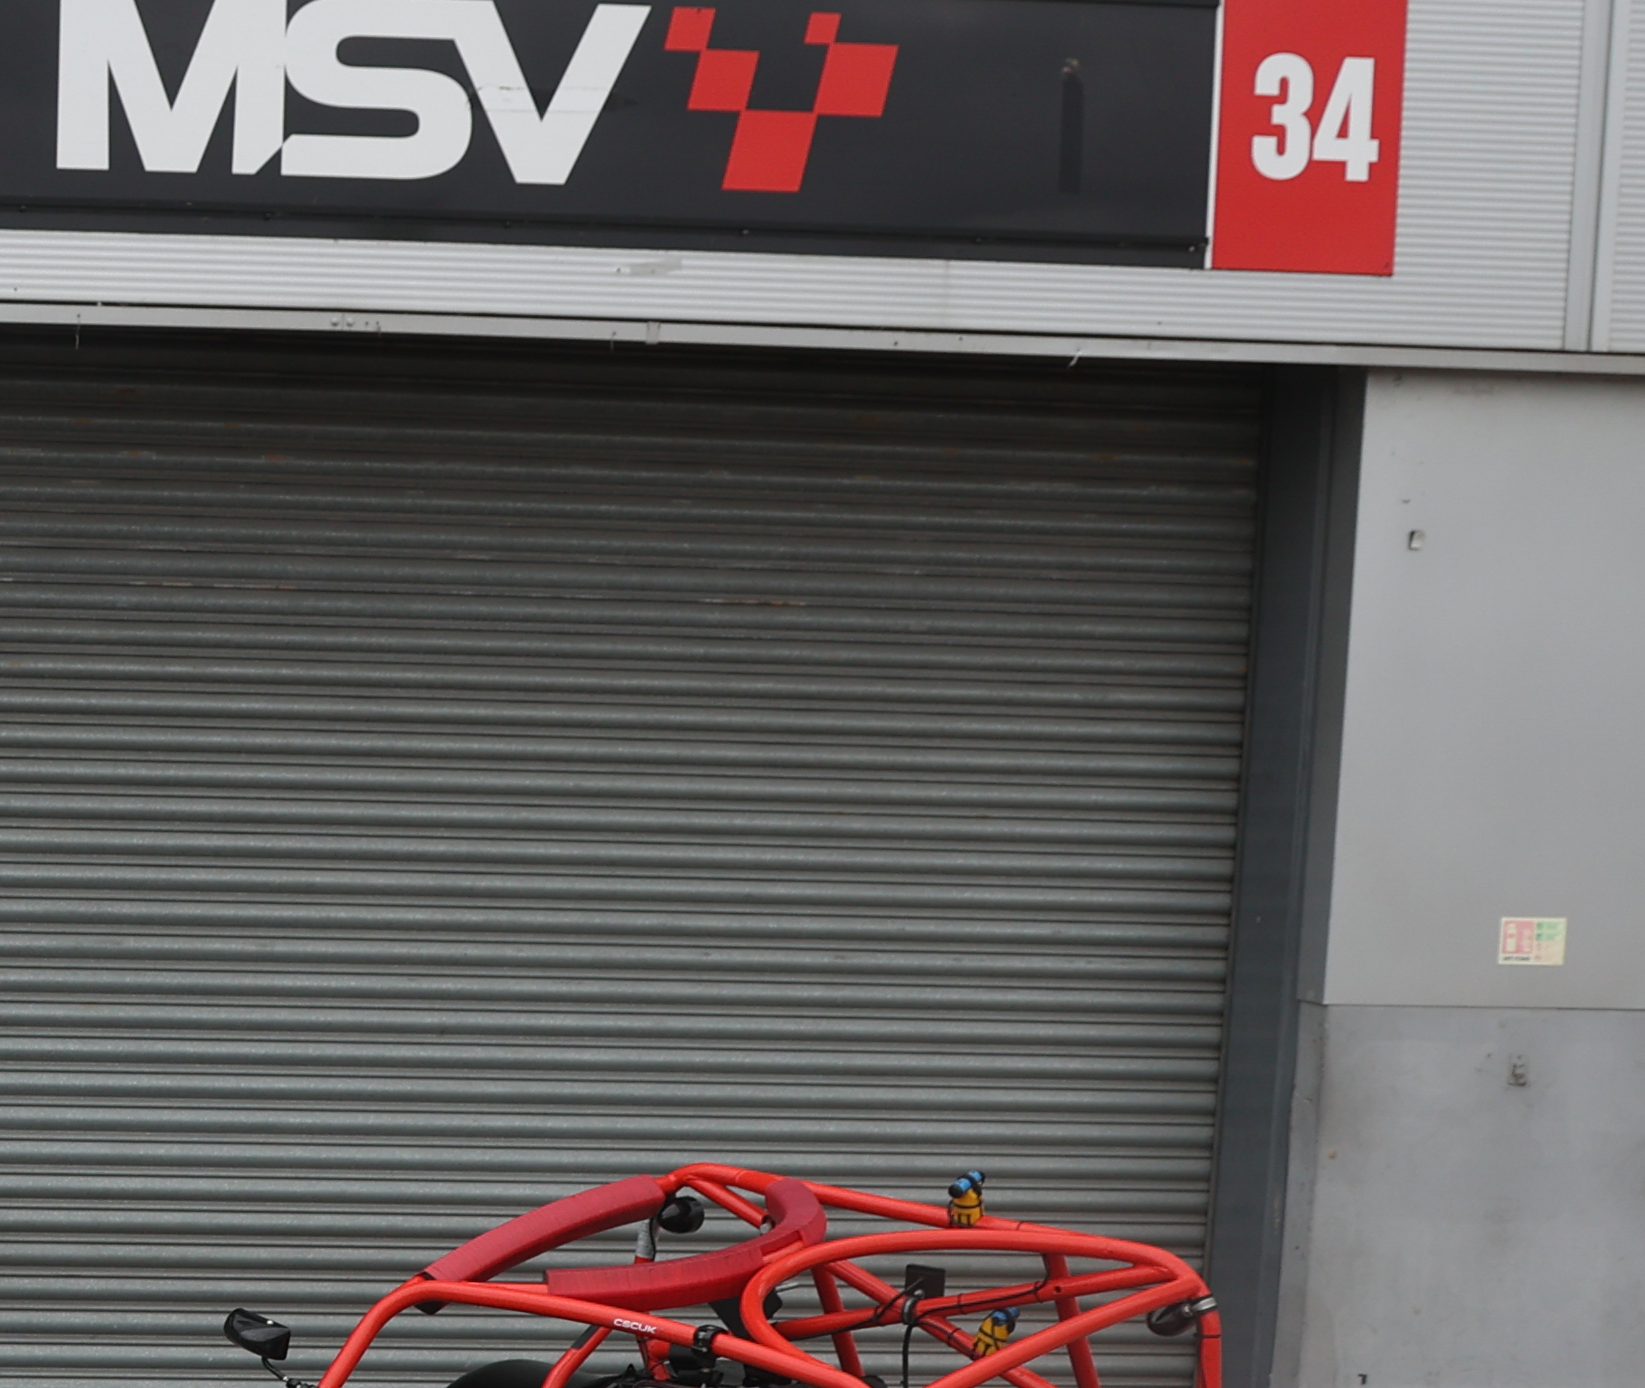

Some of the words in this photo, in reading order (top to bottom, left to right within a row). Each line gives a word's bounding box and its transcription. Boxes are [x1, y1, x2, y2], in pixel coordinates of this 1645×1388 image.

[56, 0, 652, 185] MSV
[1250, 52, 1380, 182] 34
[613, 1318, 657, 1334] CSCUK
